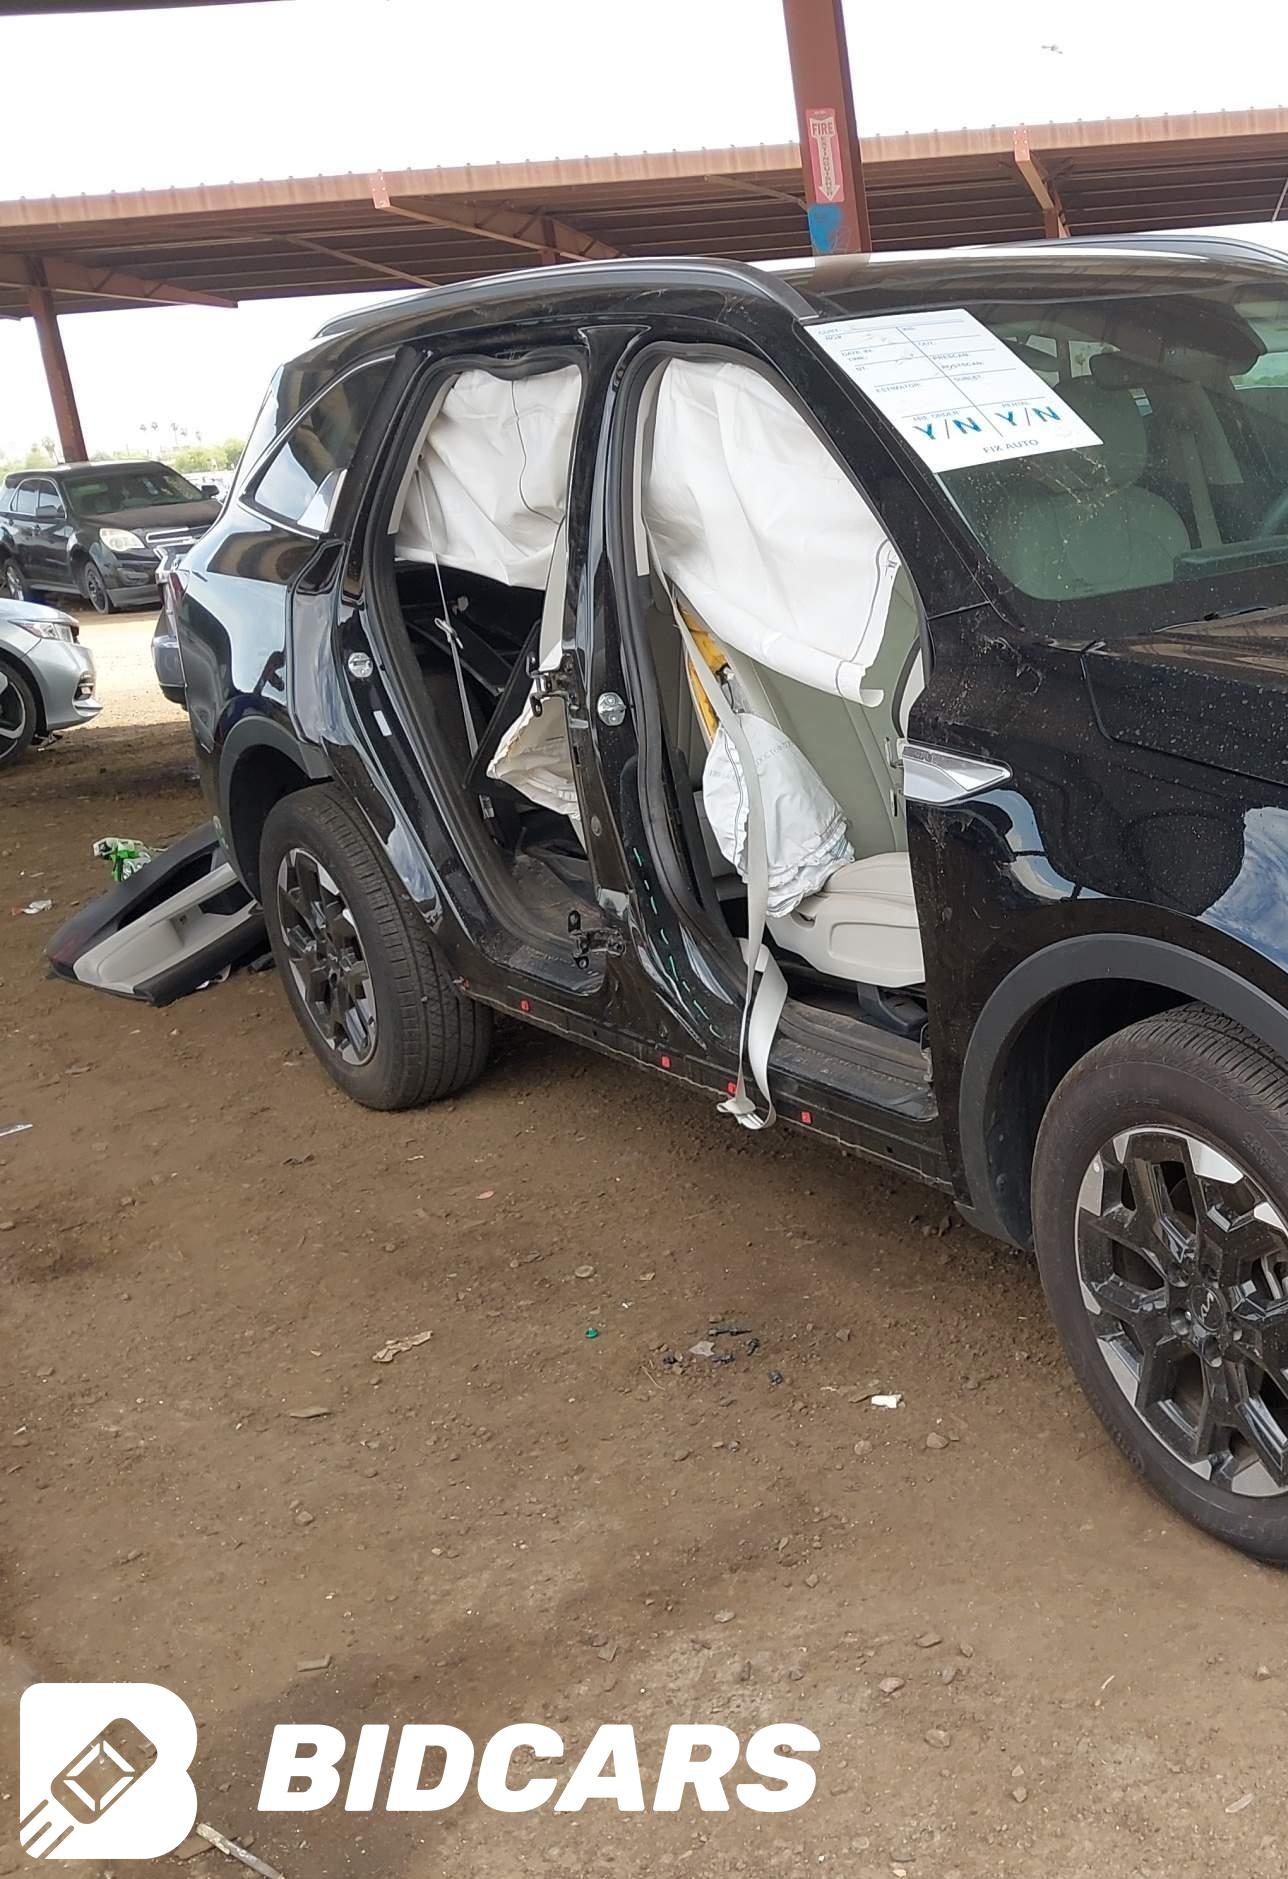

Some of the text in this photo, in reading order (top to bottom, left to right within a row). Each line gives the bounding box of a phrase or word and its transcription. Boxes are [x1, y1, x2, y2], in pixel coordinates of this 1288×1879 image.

[812, 122, 834, 137] FIRE
[982, 438, 1039, 453] FIX AUTO
